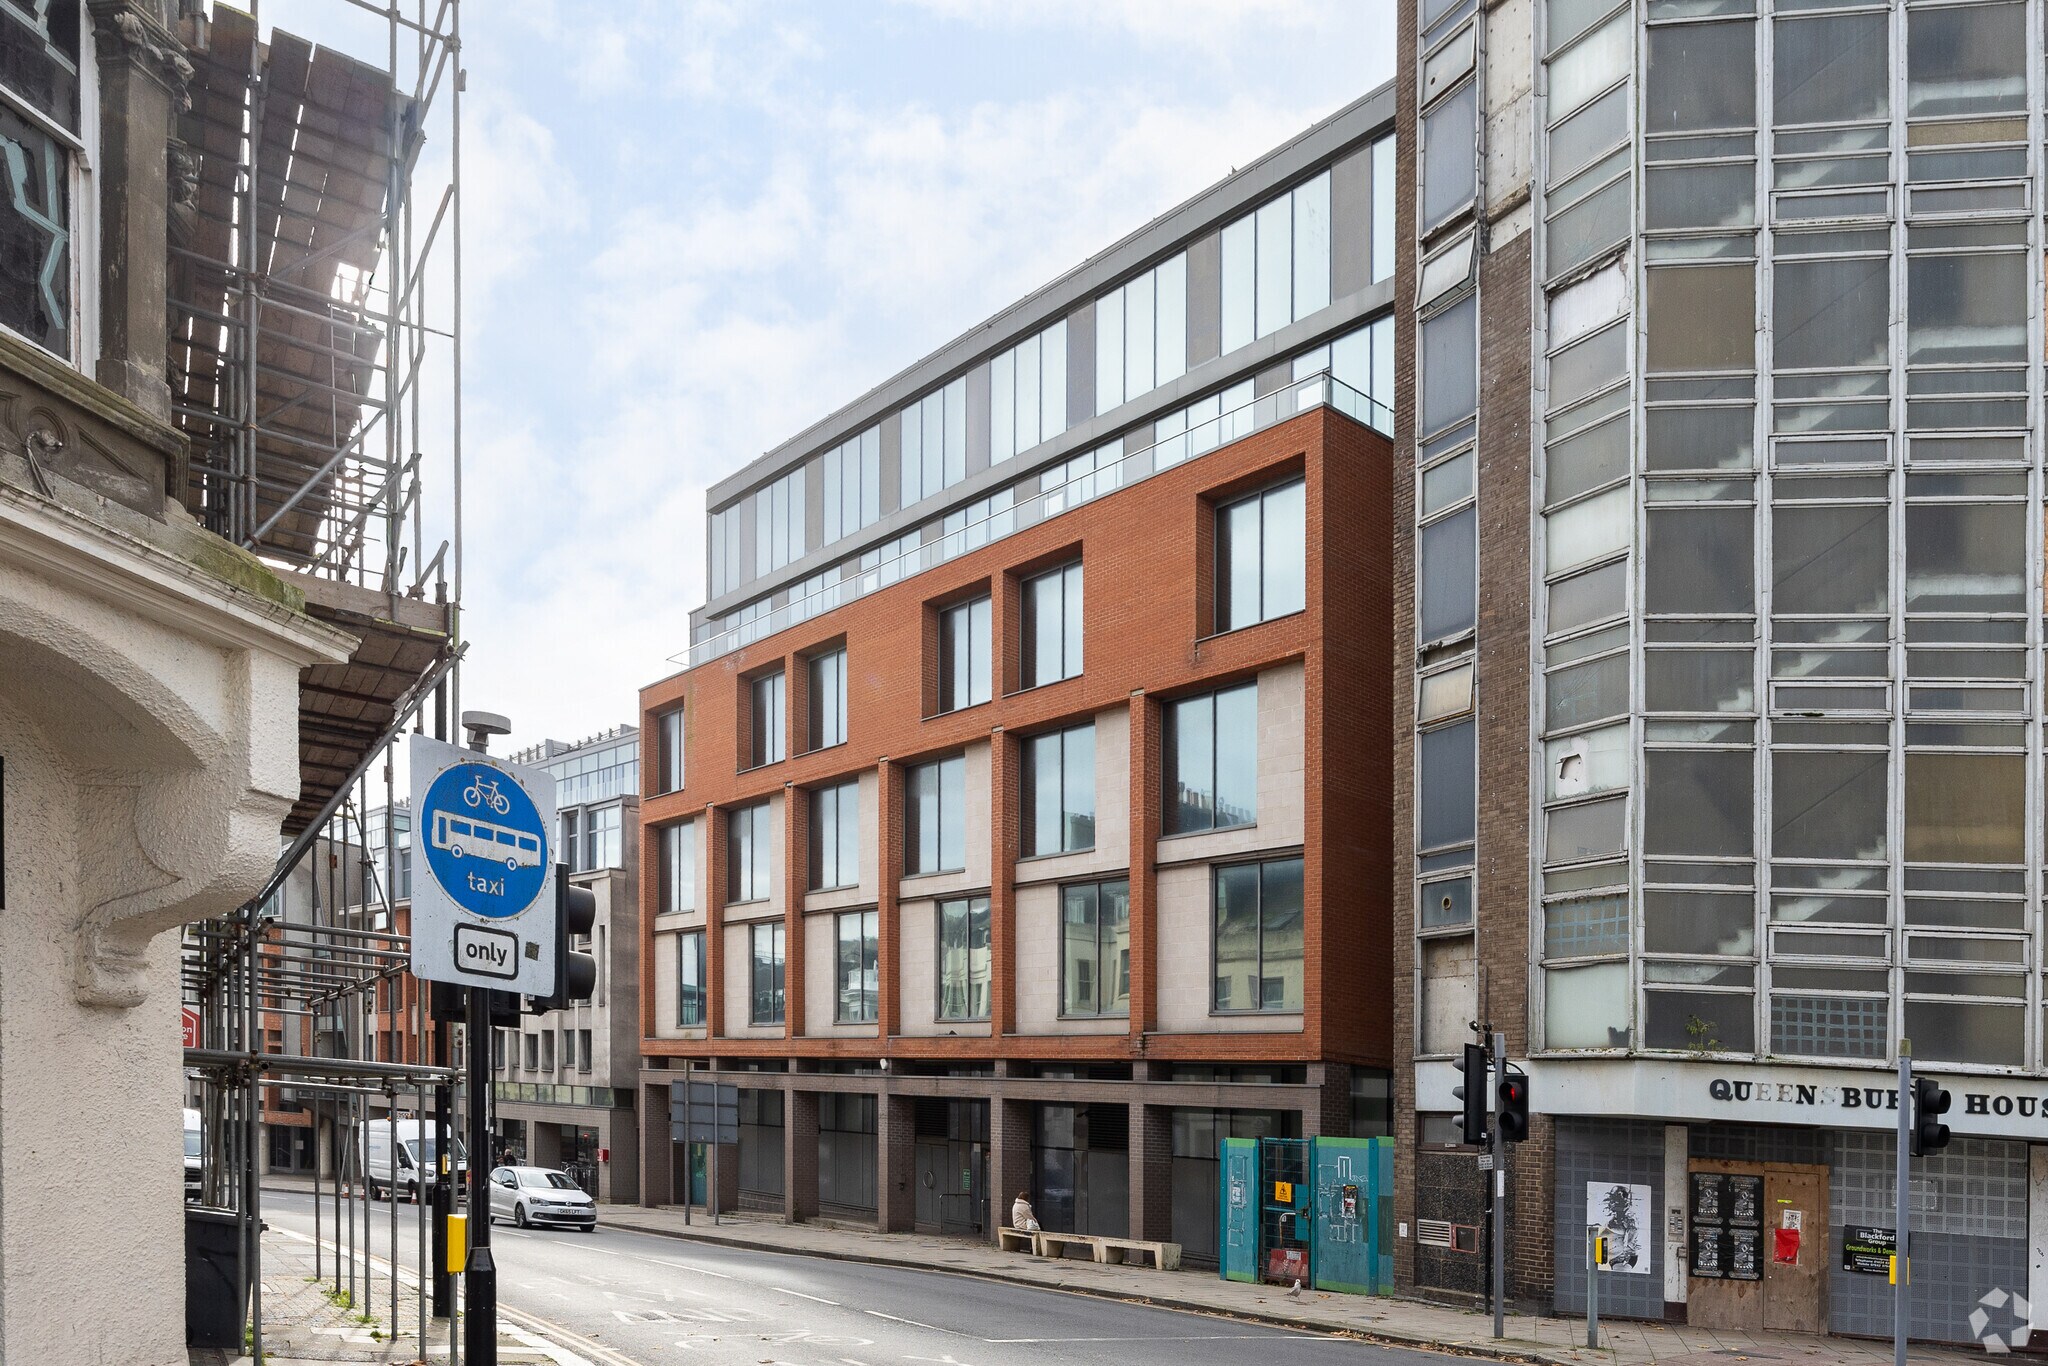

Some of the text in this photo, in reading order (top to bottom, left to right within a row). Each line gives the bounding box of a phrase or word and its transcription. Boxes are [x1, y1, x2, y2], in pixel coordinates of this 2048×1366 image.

[467, 871, 505, 896] taxi
[466, 942, 507, 966] only
[1860, 1232, 1895, 1241] Blackford
[1867, 1238, 1887, 1246] Group
[1846, 1244, 1876, 1253] Groundworks
